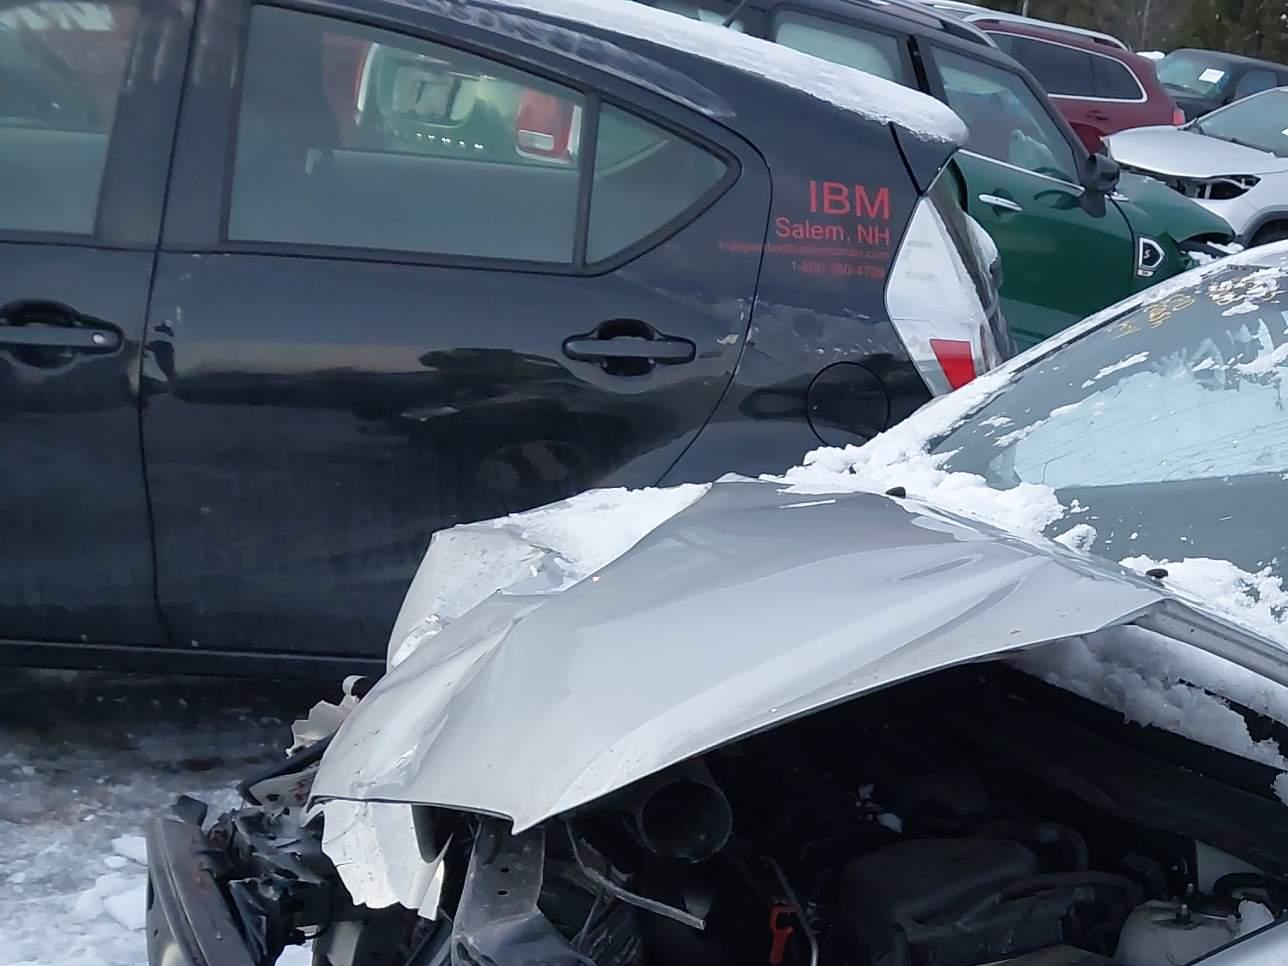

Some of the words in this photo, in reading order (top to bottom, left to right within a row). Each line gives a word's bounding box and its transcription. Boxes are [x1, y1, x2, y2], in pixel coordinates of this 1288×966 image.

[809, 180, 889, 220] IBM
[775, 216, 851, 242] Salem,
[857, 223, 890, 246] NH
